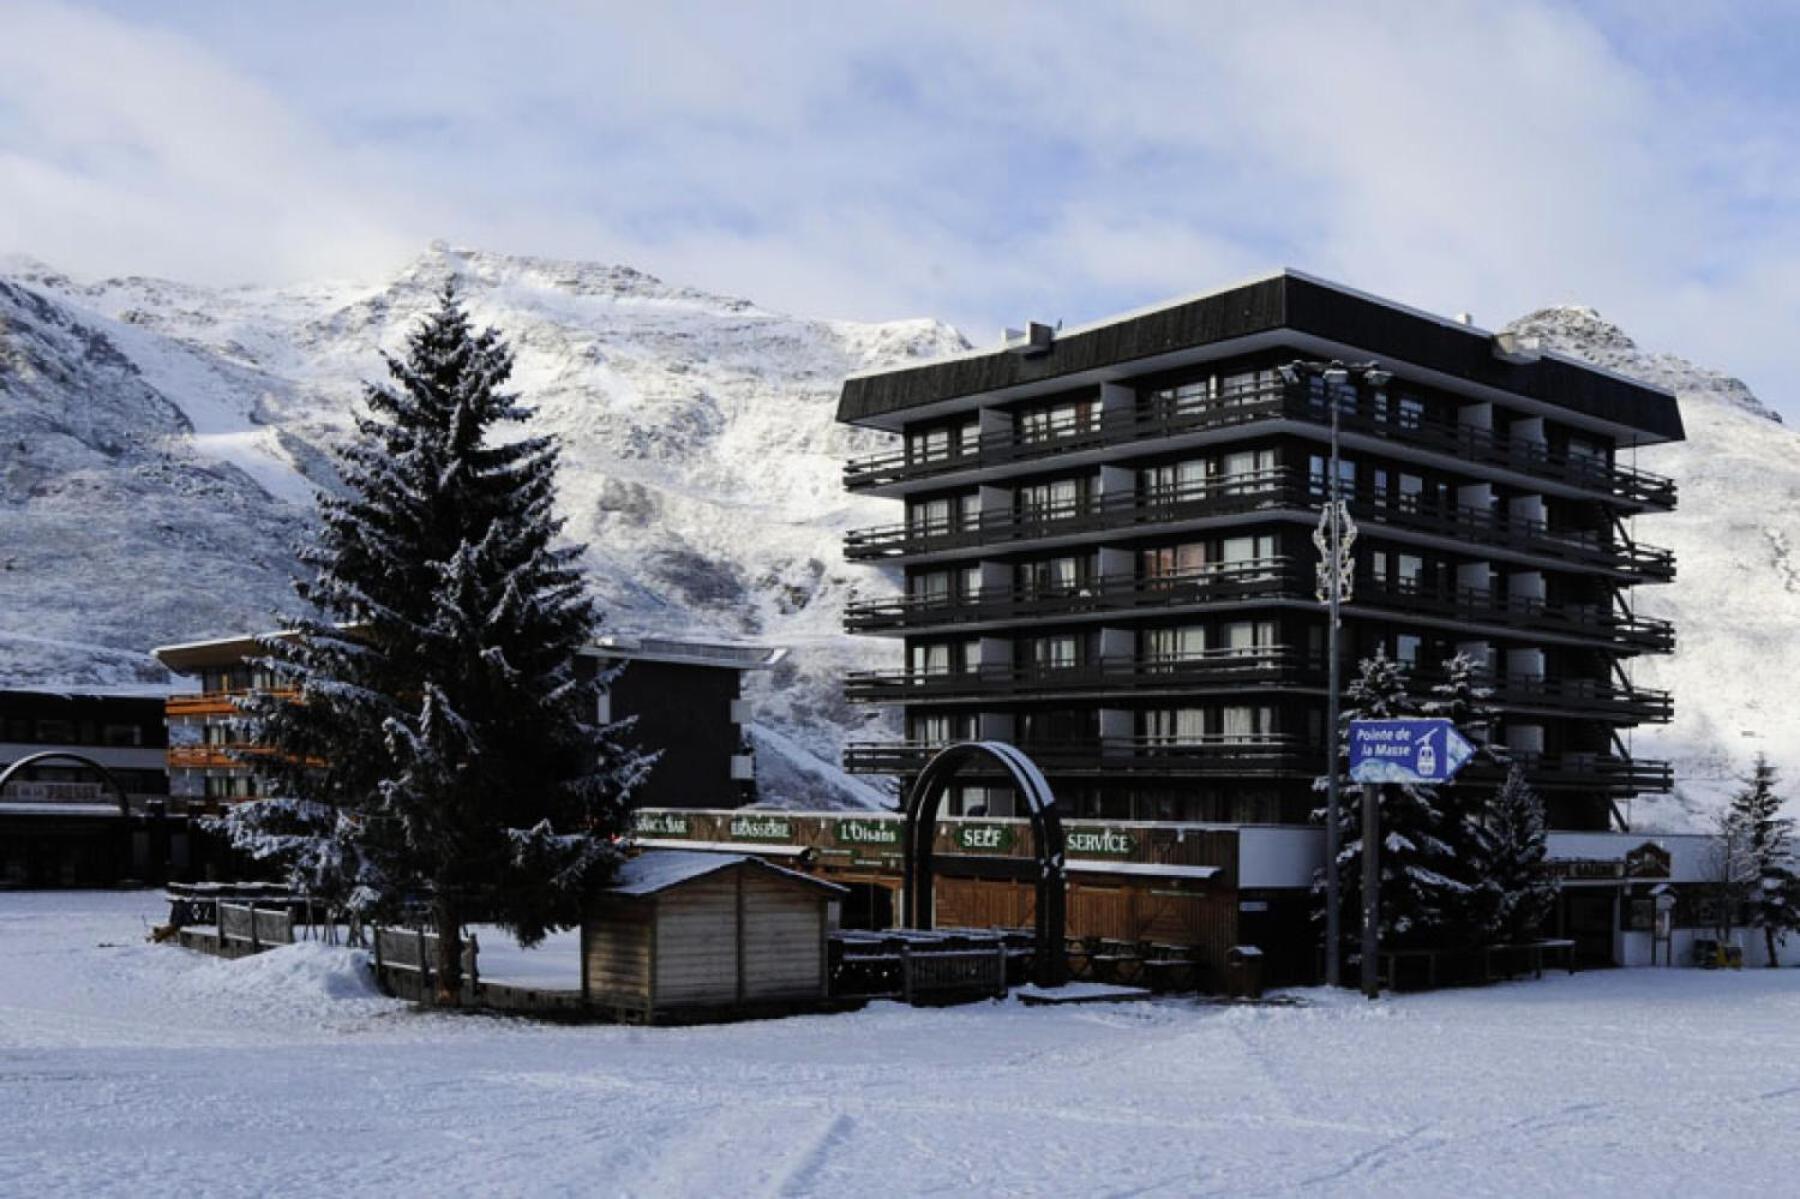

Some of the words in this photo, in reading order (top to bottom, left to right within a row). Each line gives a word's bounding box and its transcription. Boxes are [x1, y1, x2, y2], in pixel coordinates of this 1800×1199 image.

[1357, 728, 1393, 741] Pointe
[1395, 727, 1411, 741] de
[1361, 745, 1373, 757] la
[1375, 744, 1411, 756] Masse
[963, 829, 1002, 847] SELF
[1066, 833, 1129, 852] SERVICE
